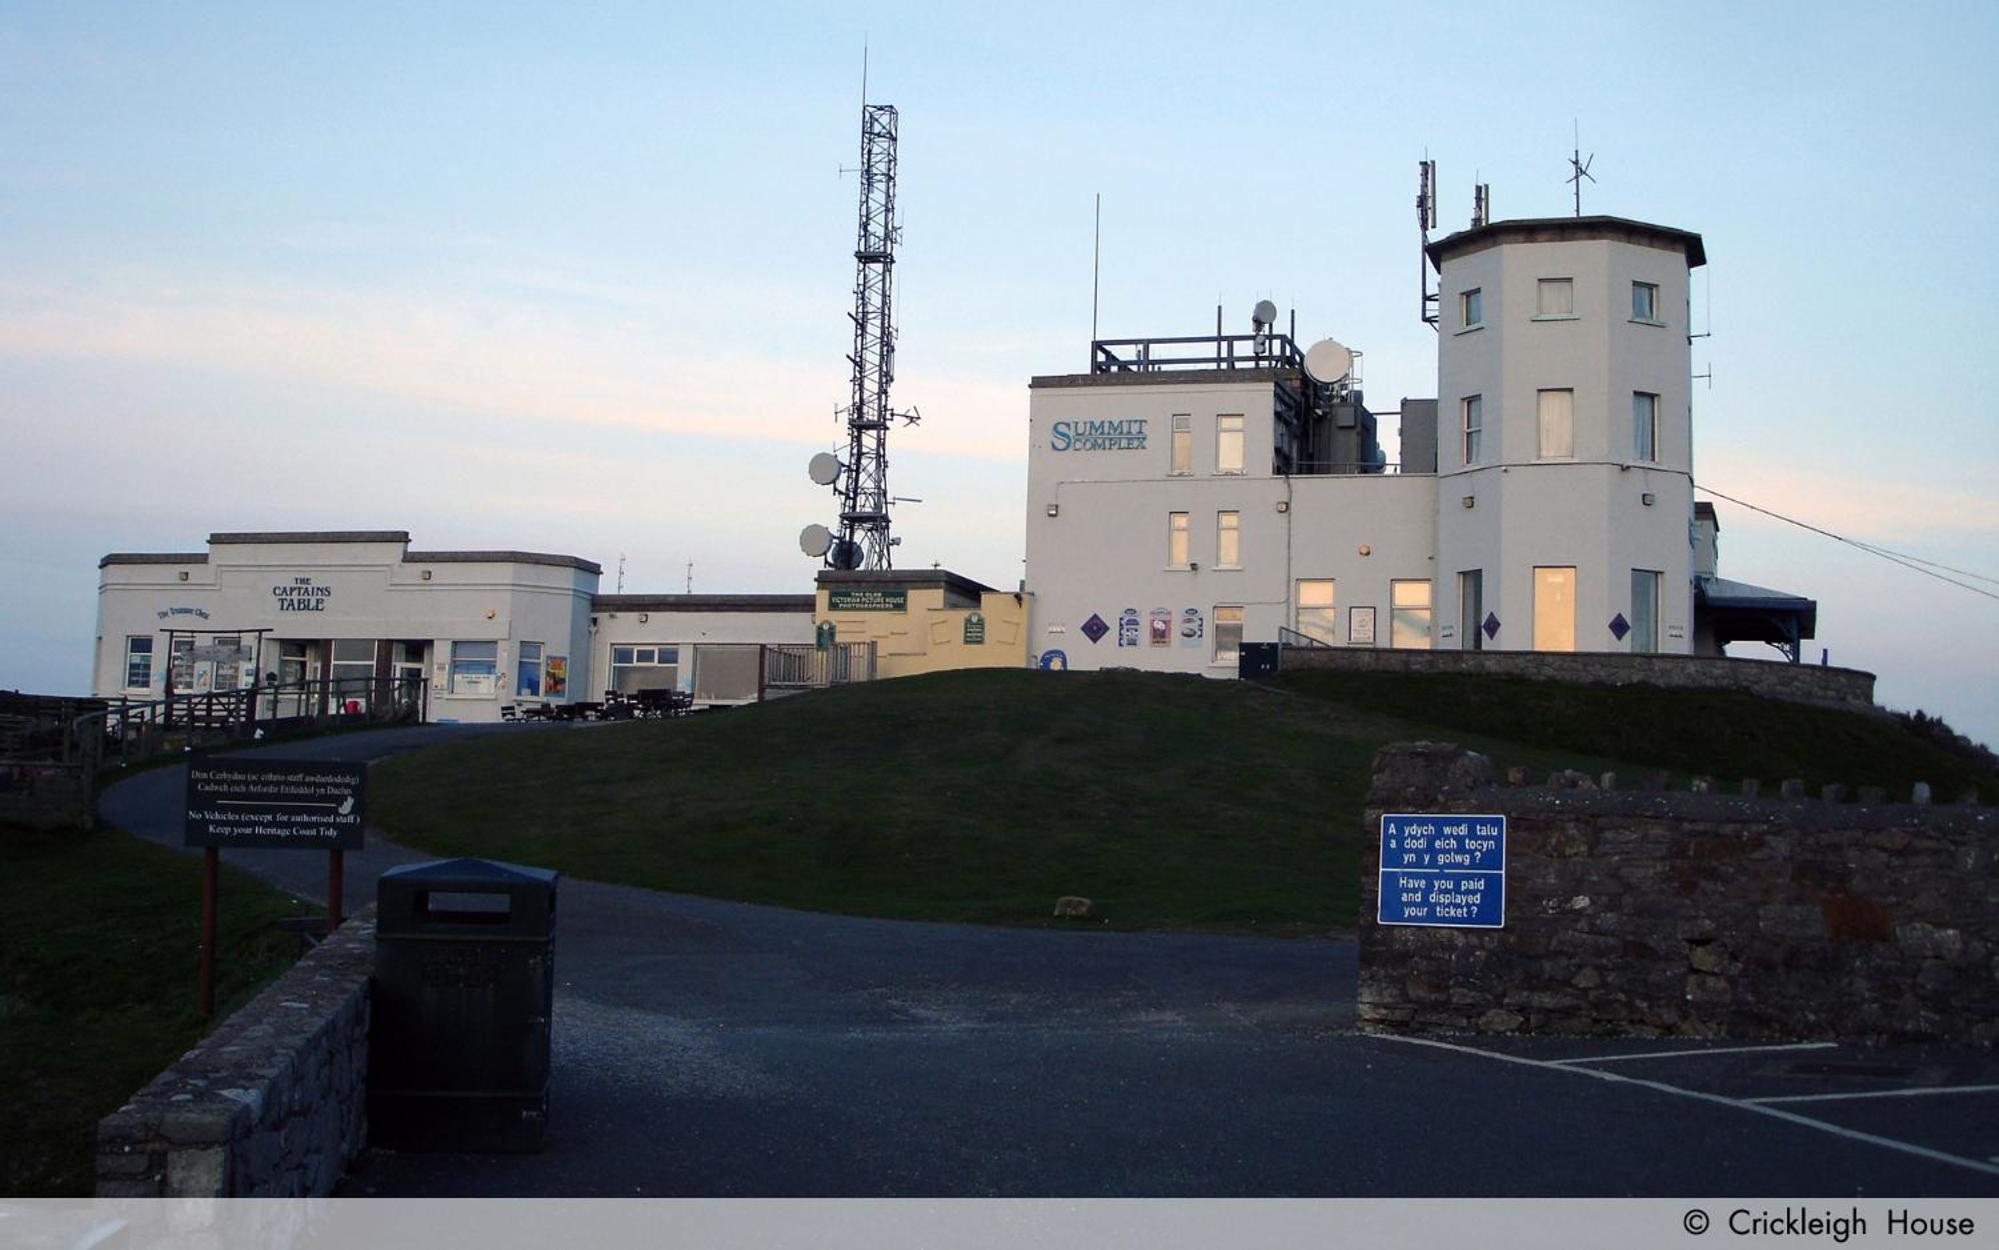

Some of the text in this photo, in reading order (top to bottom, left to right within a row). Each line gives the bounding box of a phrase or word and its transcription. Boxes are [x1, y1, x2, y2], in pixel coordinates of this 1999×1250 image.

[1051, 420, 1148, 451] SUMMIT
[1073, 437, 1148, 451] COMPLEX
[294, 577, 311, 585] THE
[273, 586, 331, 597] CAPTAINS
[277, 598, 325, 611] TABLE
[188, 810, 202, 819] No
[204, 810, 239, 820] Vehicles
[241, 812, 273, 823] (except
[276, 812, 289, 822] for
[290, 813, 334, 823] authorised
[208, 825, 338, 839] Keep your Heritage Coast Tidy
[1388, 823, 1498, 837] A ydych wedi talu
[1390, 838, 1495, 851] a dodi eich tocyn
[1403, 853, 1416, 863] yn
[1424, 853, 1430, 864] y
[1399, 877, 1485, 890] Have you paid
[1401, 892, 1481, 905] and displayed
[1403, 907, 1428, 918] your
